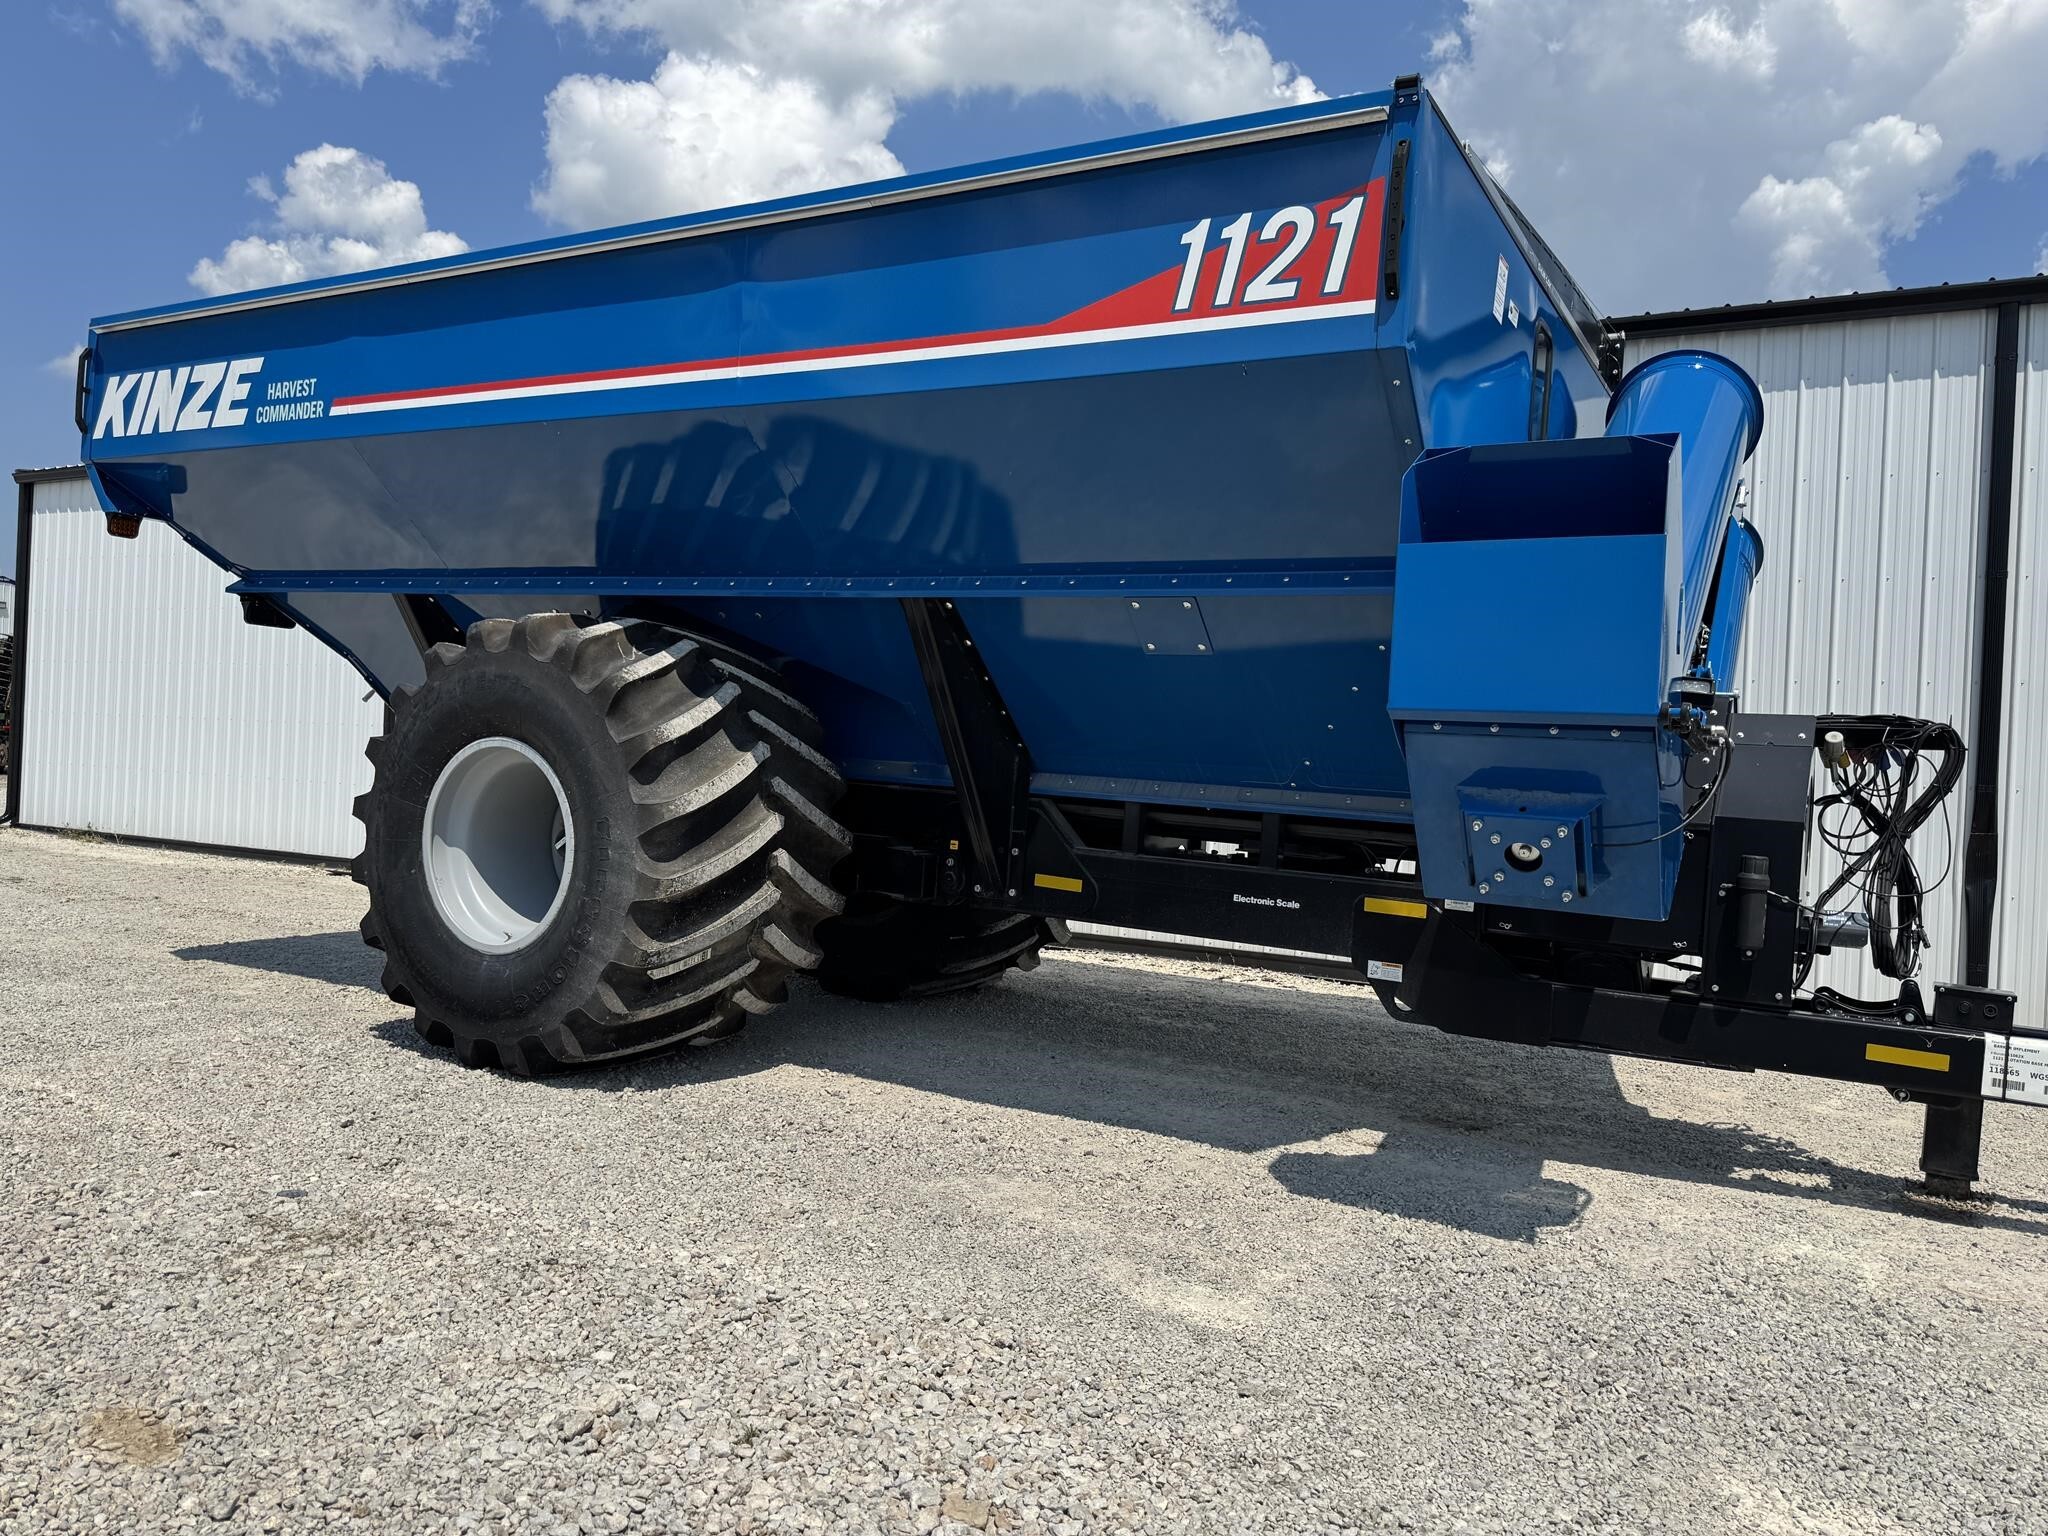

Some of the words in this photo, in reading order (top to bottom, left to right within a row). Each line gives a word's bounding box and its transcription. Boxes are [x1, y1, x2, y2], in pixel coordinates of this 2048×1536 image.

[1172, 194, 1366, 312] 1121
[92, 356, 265, 440] KINZE
[267, 378, 317, 401] HARVEST
[255, 401, 324, 424] COMMANDER
[1233, 894, 1275, 906] Electronic
[1276, 898, 1300, 909] Scale
